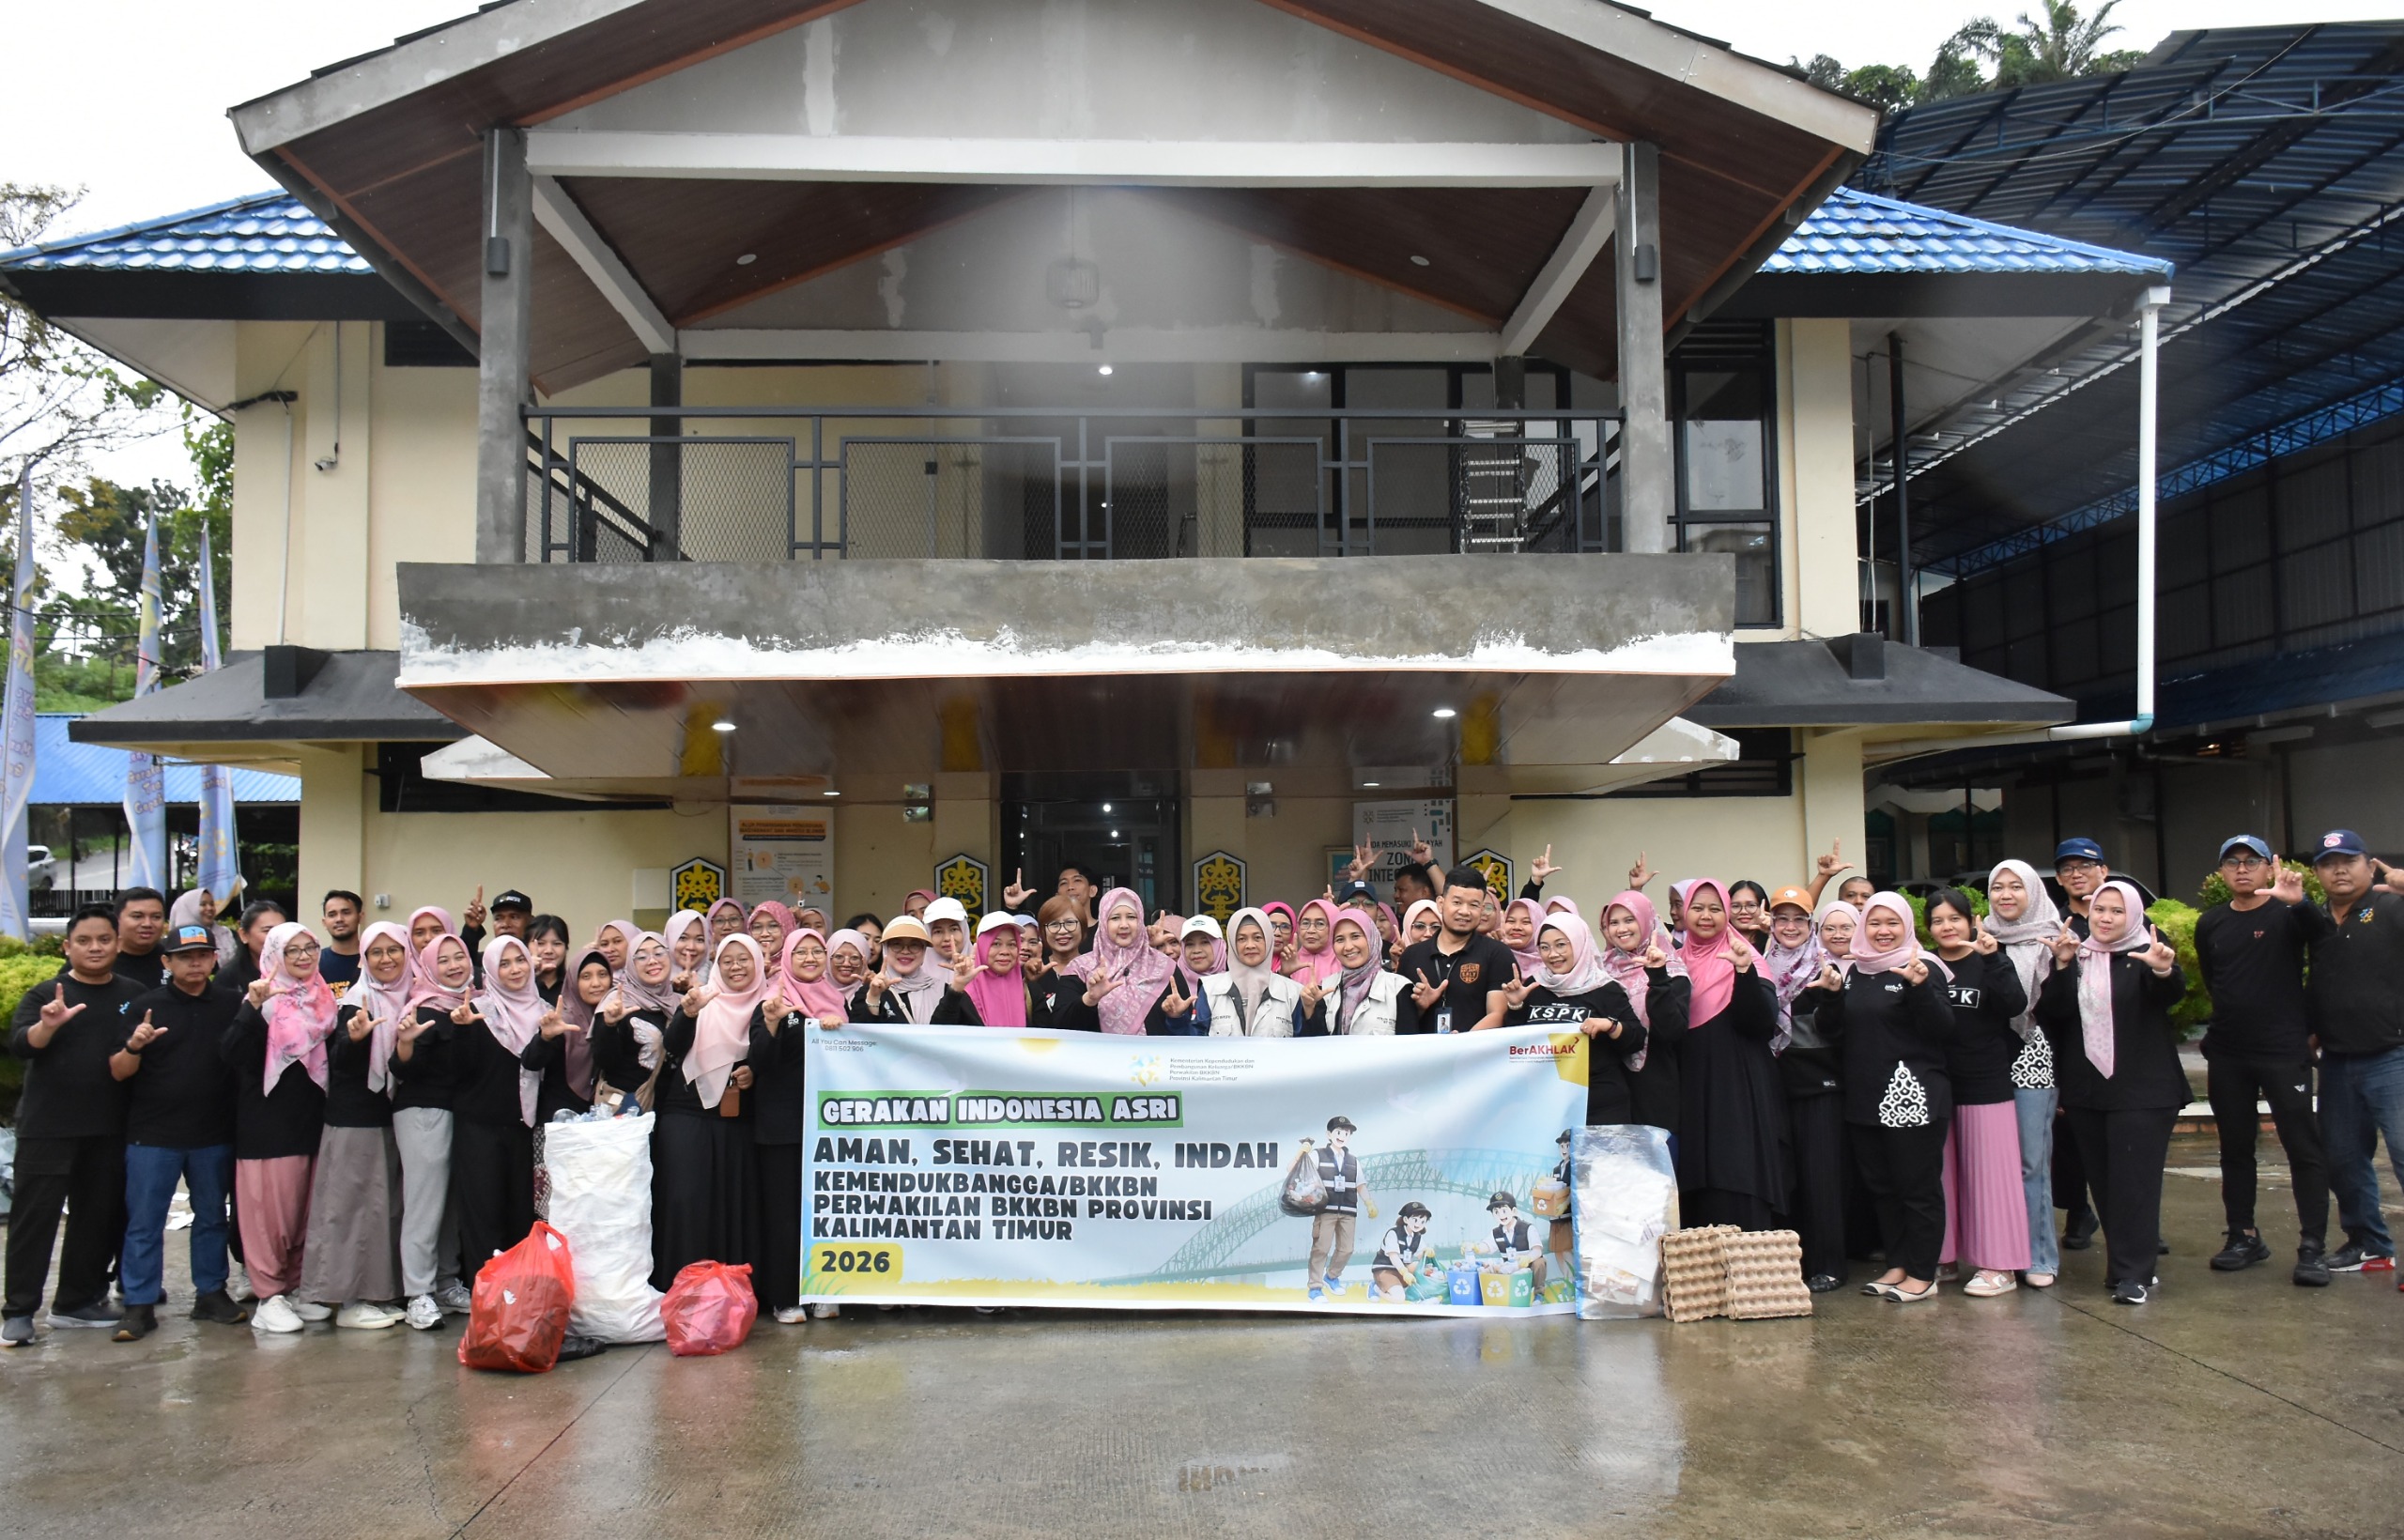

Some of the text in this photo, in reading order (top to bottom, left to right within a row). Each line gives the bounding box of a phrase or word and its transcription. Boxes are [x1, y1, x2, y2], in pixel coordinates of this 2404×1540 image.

[1381, 839, 1411, 848] MEMASUKI
[1529, 1007, 1586, 1022] KSPK
[1509, 1044, 1576, 1055] BerAKHLAK
[822, 1097, 1179, 1124] GERAKAN INDONESIA ASRI
[813, 1136, 1278, 1170] AMAN, SEHAT, RESIK, INDAH
[814, 1170, 1158, 1197] KEMENDUKBANGGA/BKKBN
[813, 1194, 1212, 1221] PERWAKILAN BKKBN PROVINSI
[812, 1216, 1072, 1240] KALIMANTAN TIMUR
[821, 1250, 891, 1273] 2026
